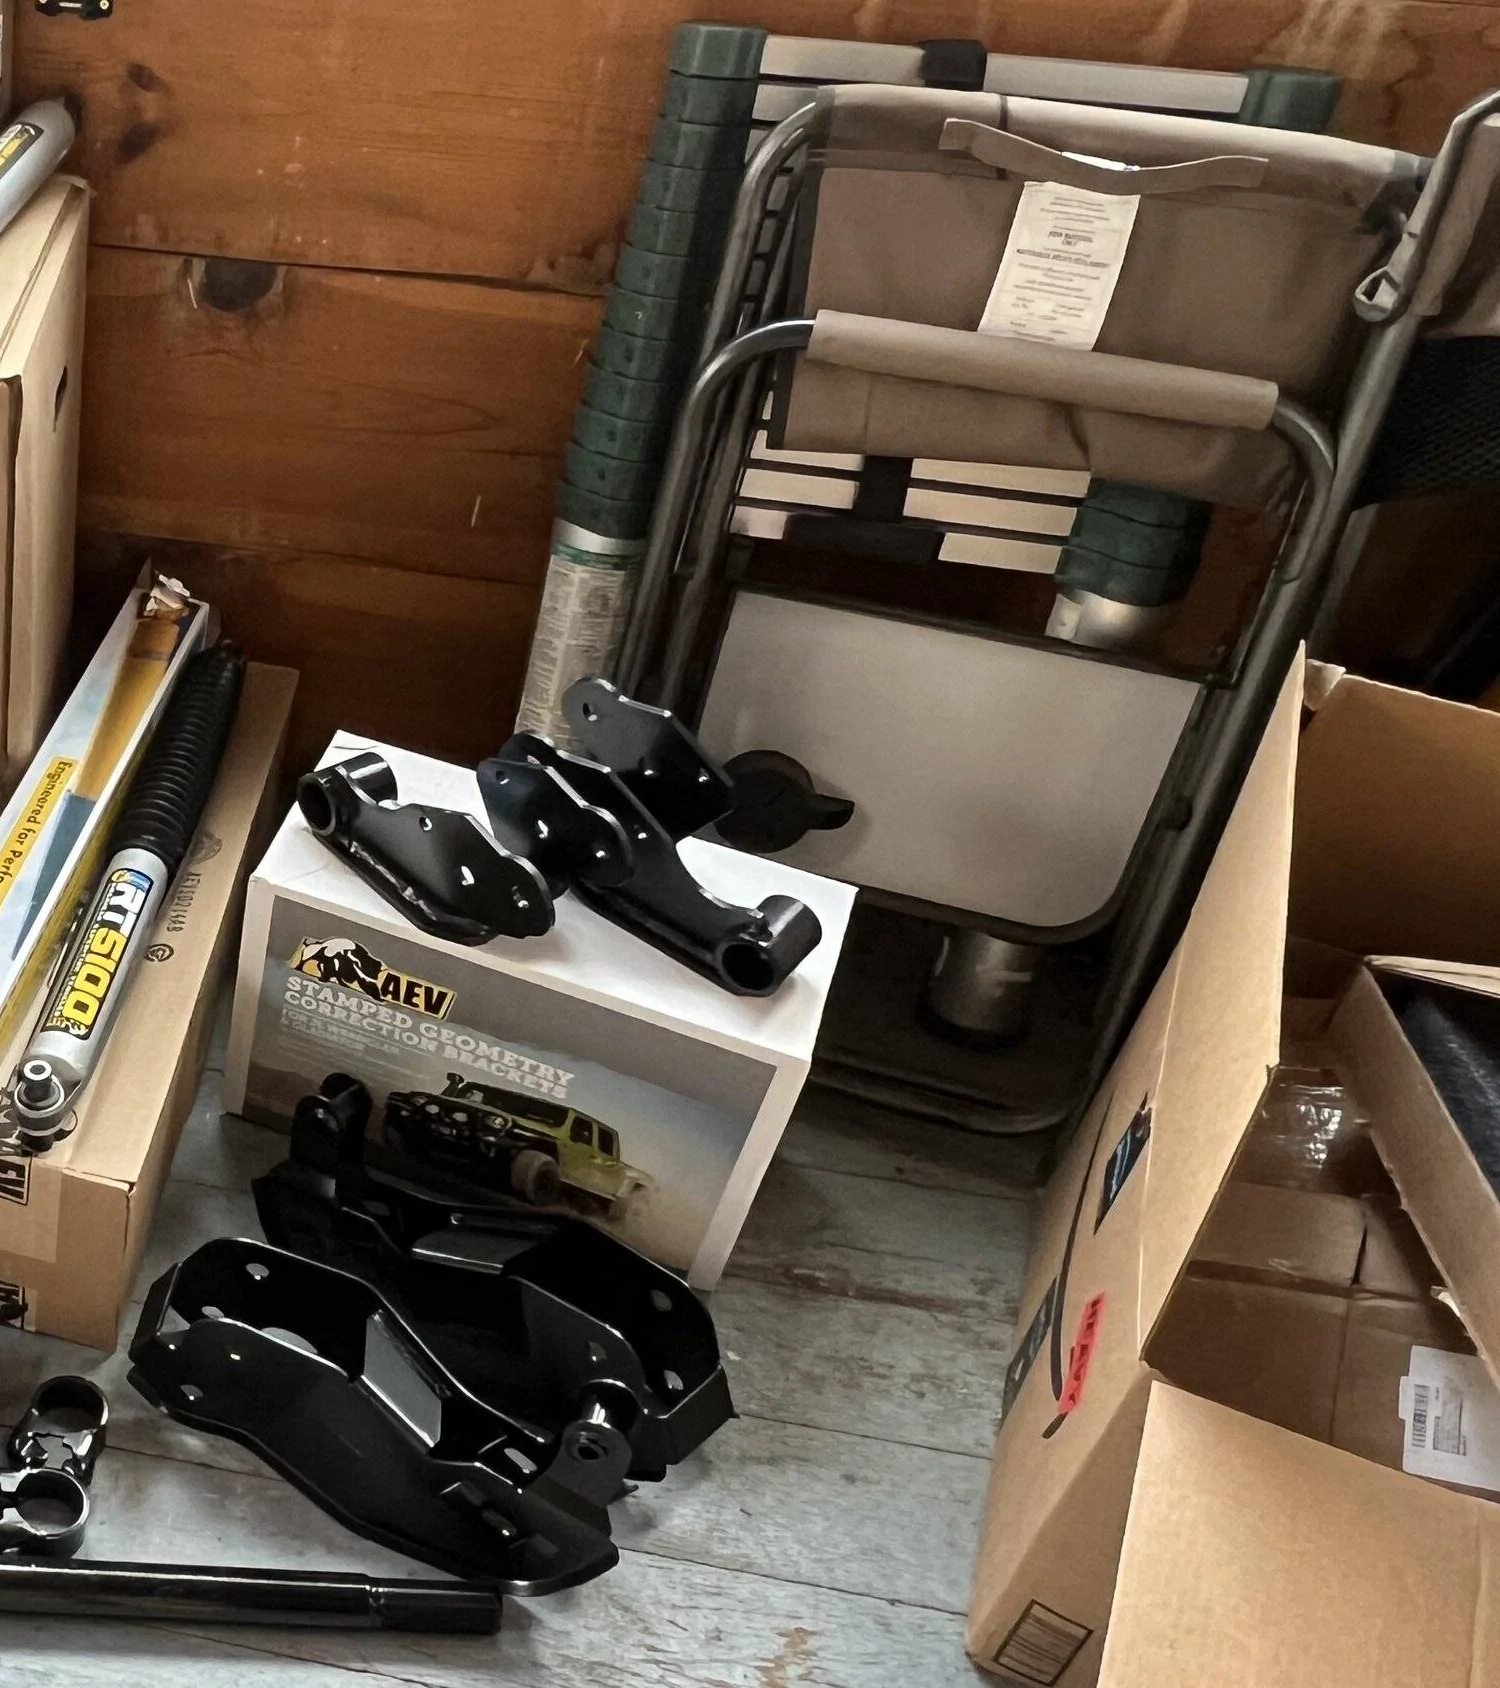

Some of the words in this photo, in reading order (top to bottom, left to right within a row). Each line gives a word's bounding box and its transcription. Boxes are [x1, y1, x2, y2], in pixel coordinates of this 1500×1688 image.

[27, 761, 73, 824] Engineered
[16, 827, 36, 846] for
[380, 972, 447, 1016] AEV
[284, 991, 438, 1052] CORRECTION
[443, 1045, 568, 1099] BRACKETS
[286, 976, 412, 1028] STAMPED
[419, 1023, 575, 1086] GEOMETRY
